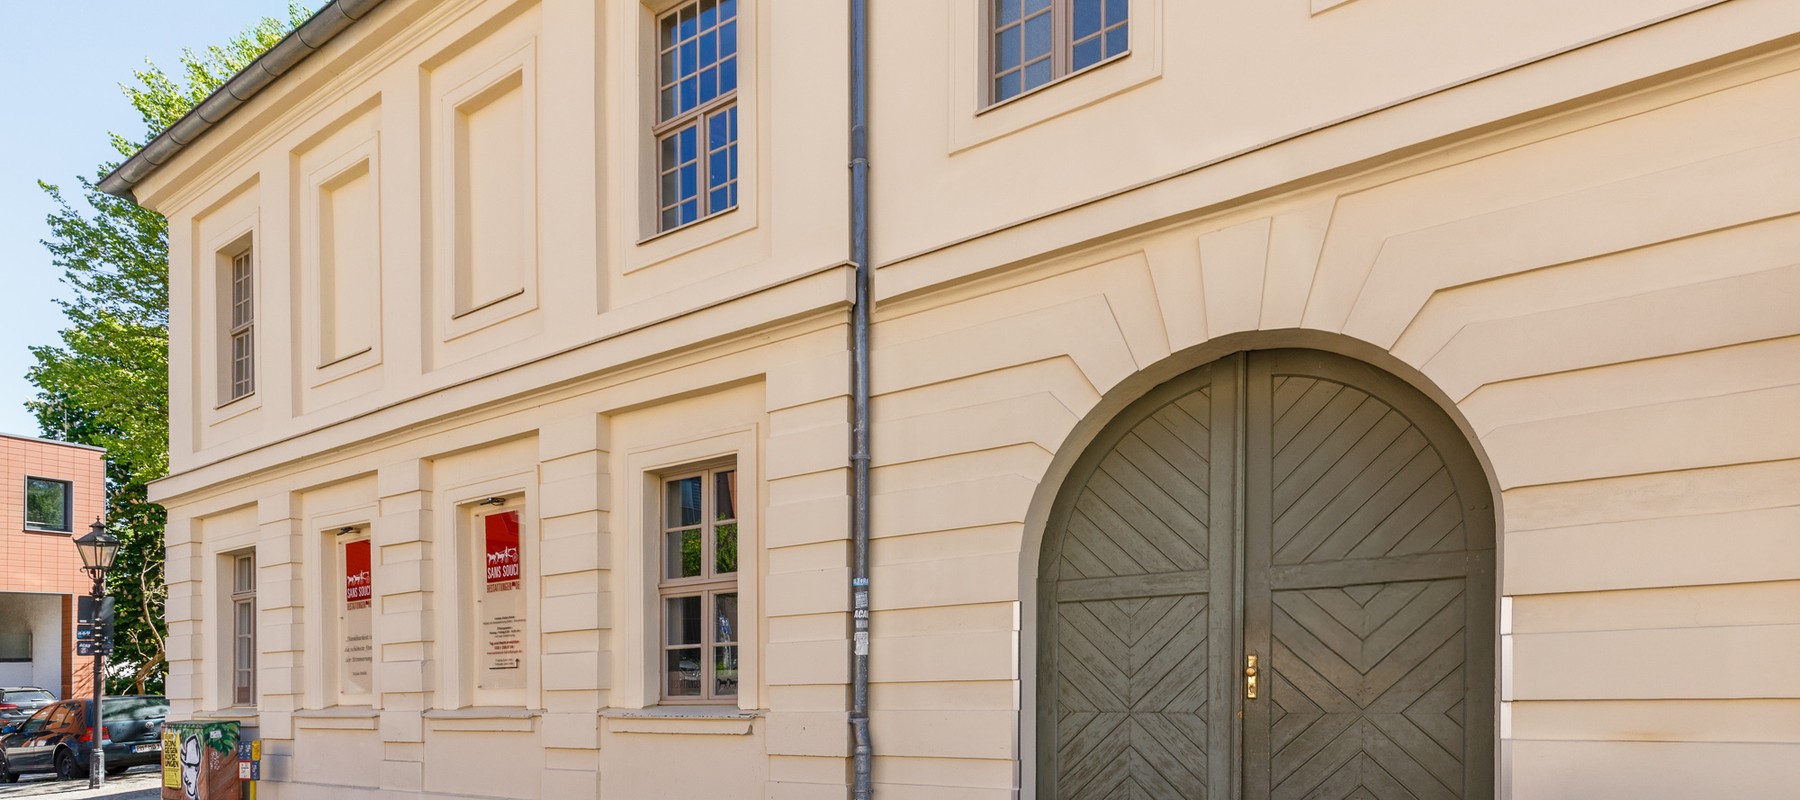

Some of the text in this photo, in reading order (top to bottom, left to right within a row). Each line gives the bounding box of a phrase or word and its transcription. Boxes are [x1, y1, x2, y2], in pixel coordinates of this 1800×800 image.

[487, 563, 519, 579] SANS SOUCI
[347, 585, 371, 599] SANS SOUCI
[854, 609, 868, 618] ACA
